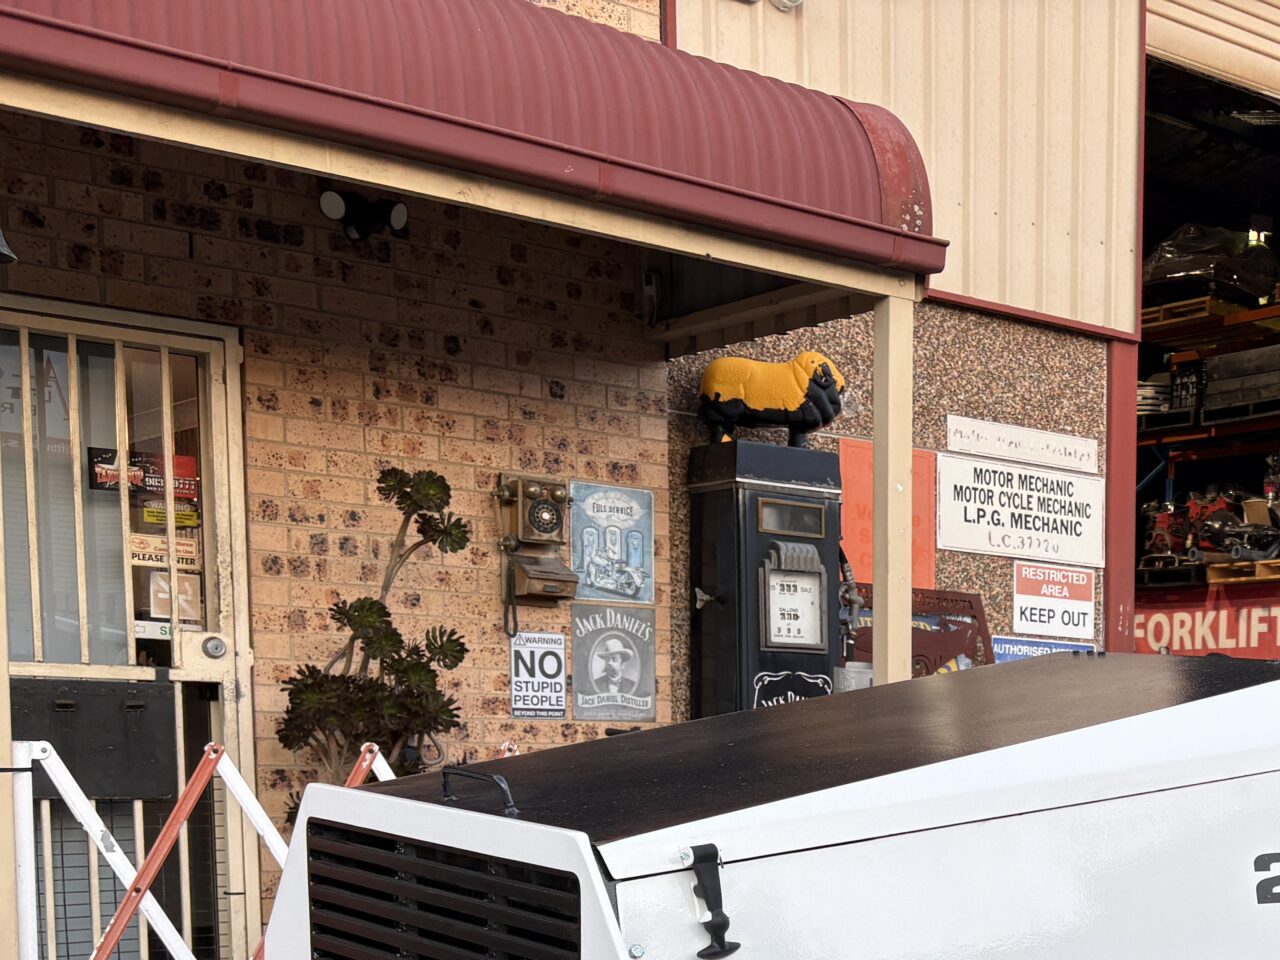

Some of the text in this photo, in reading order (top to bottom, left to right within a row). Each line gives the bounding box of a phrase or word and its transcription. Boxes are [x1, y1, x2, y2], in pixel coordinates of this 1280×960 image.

[974, 467, 1075, 498] MOTOR MECHANIC
[953, 484, 1092, 519] MOTOR CYCLE MECHANIC
[592, 502, 635, 517] FULL SERVICE
[963, 506, 1083, 537] L.P.G. MECHANIC
[131, 552, 165, 563] PLEASE
[1022, 566, 1088, 585] RESTRICTED
[1040, 584, 1070, 597] AREA
[575, 608, 652, 641] JACK DANIEL'S
[1019, 606, 1089, 628] KEEP OUT
[525, 636, 563, 645] WARNING
[993, 644, 1050, 657] AUTHORISED
[514, 650, 563, 679] NO
[514, 681, 563, 693] STUPID
[514, 695, 564, 707] PEOPLE
[581, 695, 649, 708] JACK DANIEL DISTILLER
